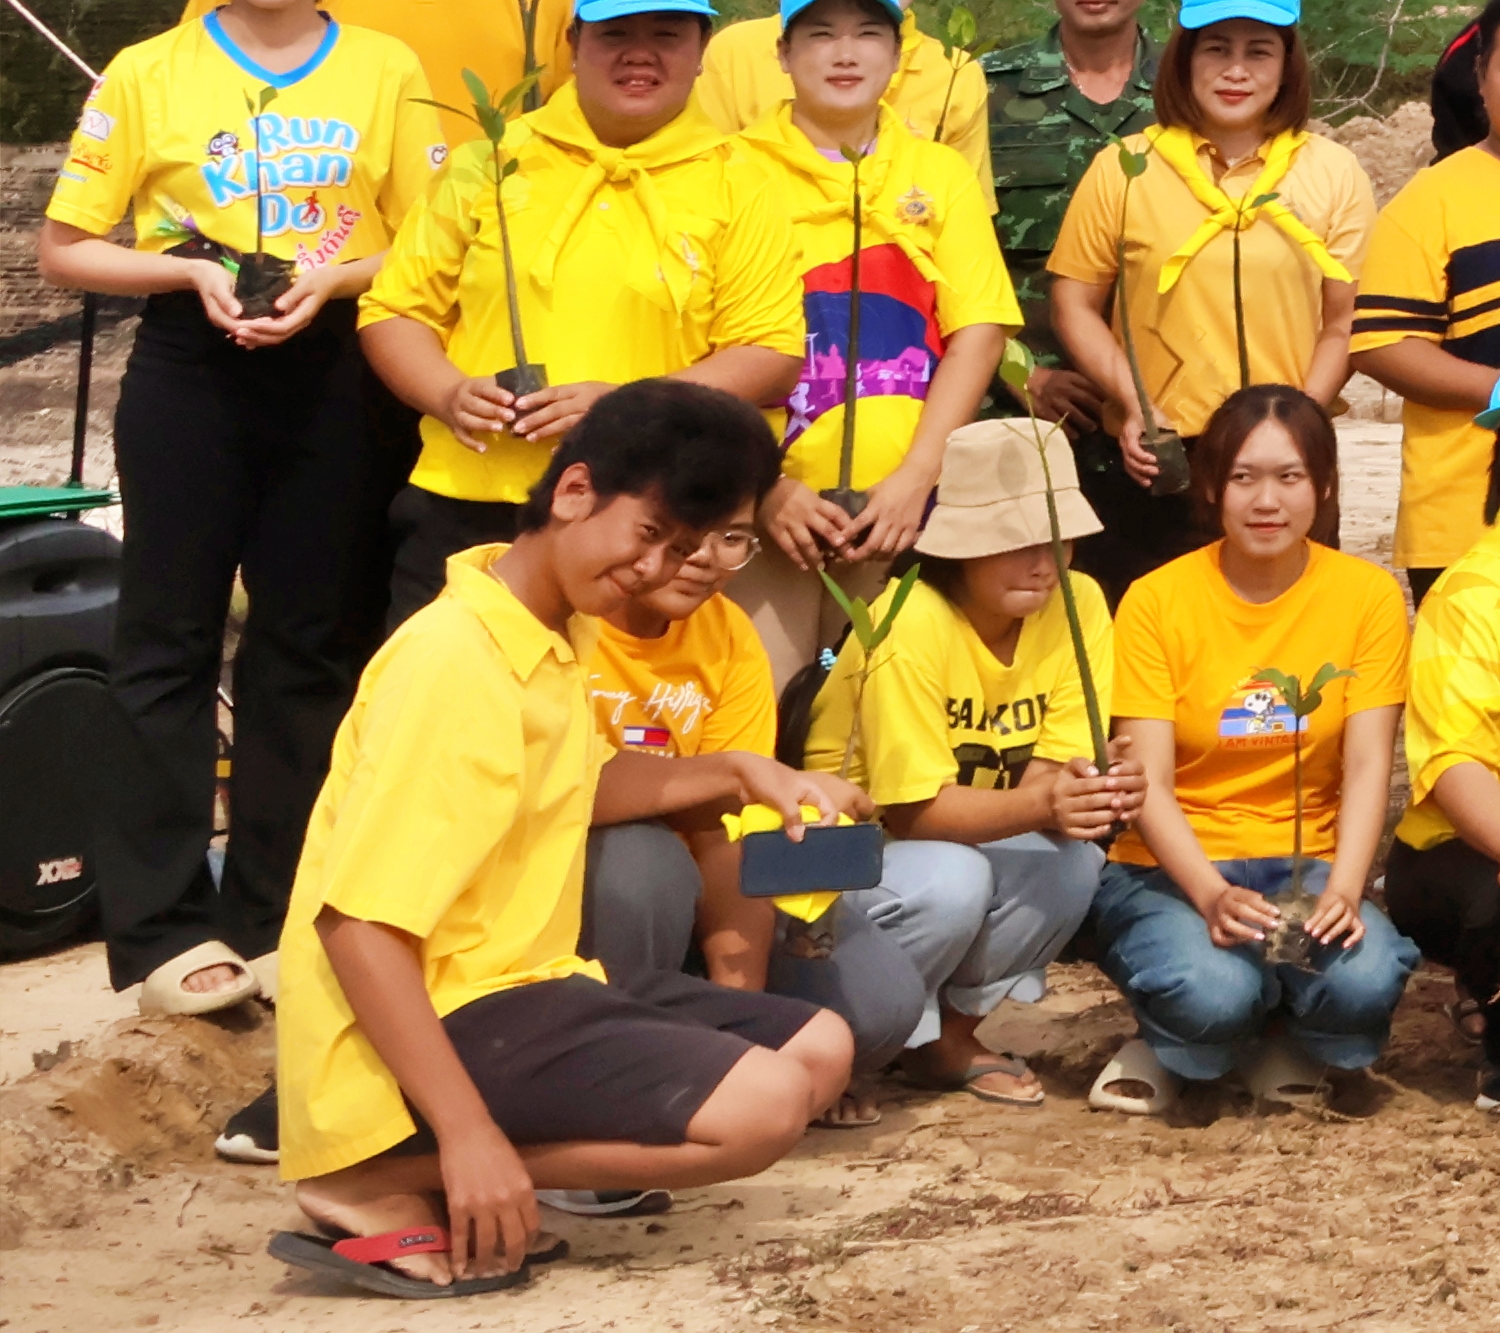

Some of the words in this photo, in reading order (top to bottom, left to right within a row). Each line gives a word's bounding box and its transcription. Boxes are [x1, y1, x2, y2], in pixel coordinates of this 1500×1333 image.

[251, 113, 360, 156] Run
[202, 150, 352, 208] Khan
[260, 193, 326, 237] Do
